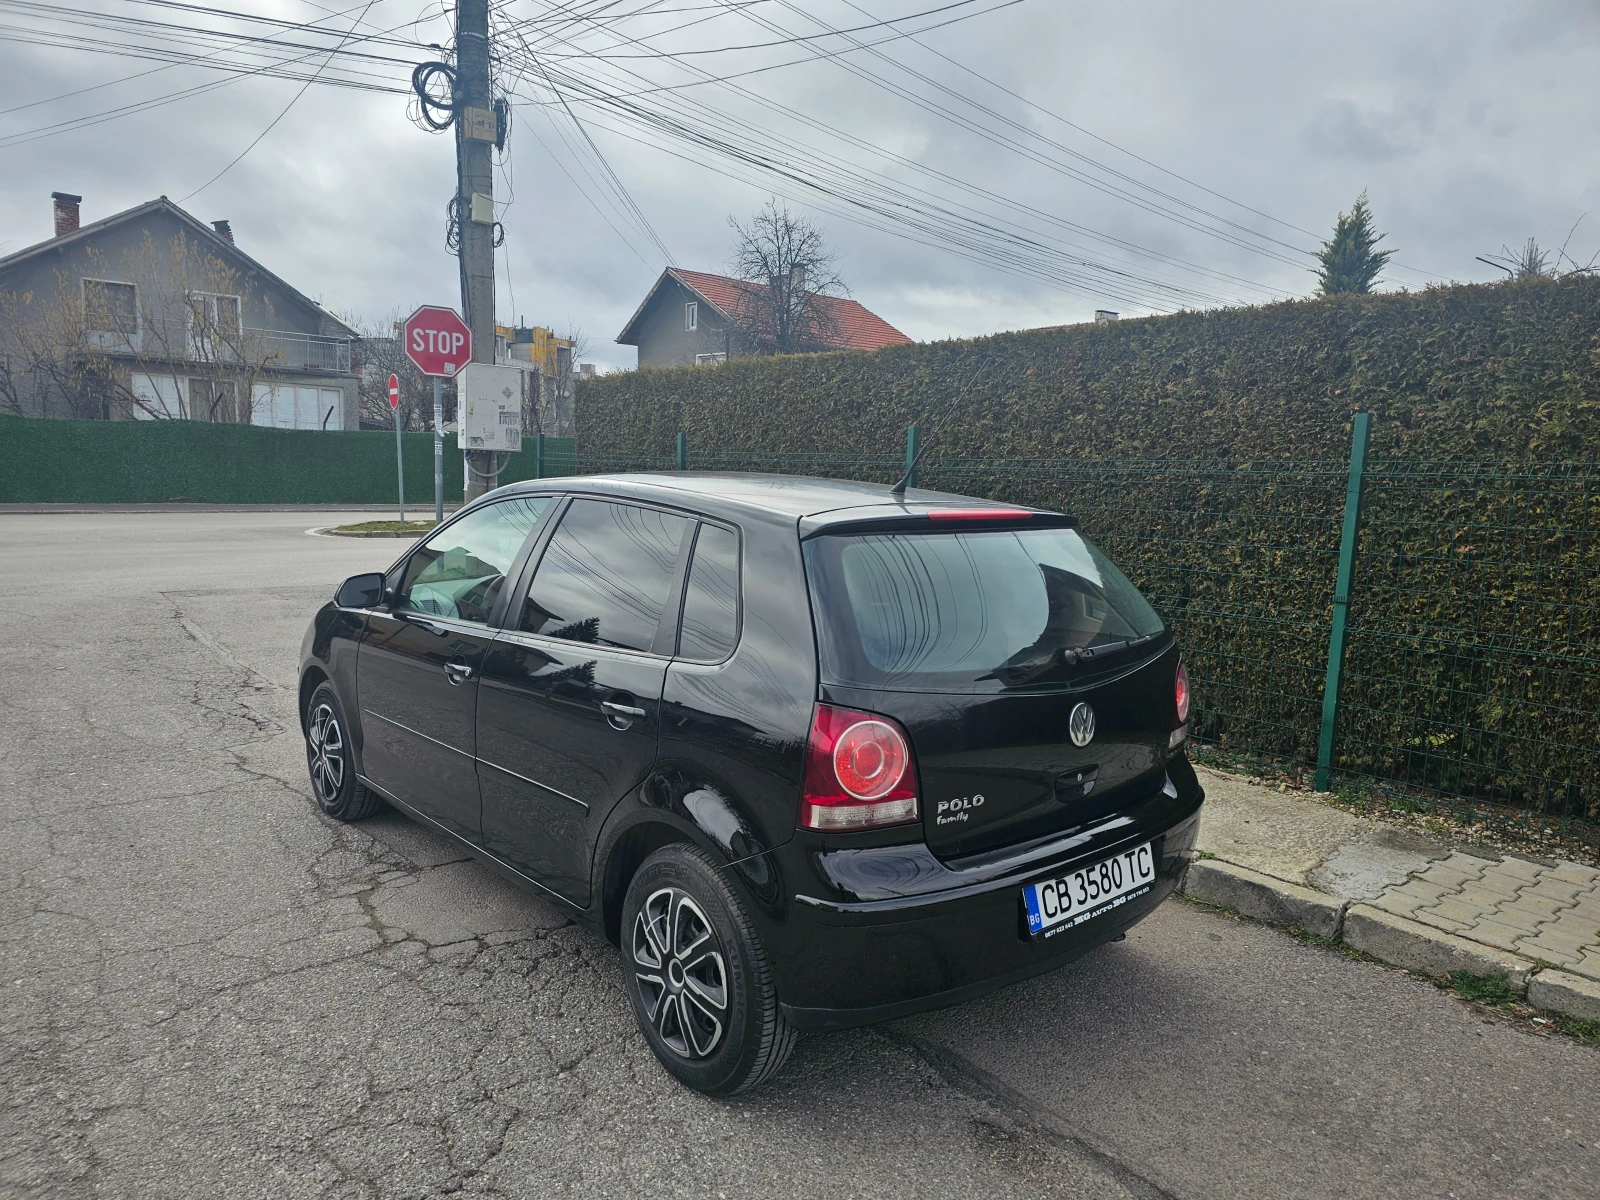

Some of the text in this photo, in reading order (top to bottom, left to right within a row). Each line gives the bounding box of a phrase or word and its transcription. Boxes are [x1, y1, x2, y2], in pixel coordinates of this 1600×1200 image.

[412, 328, 464, 355] STOP
[937, 794, 985, 814] POLO
[937, 811, 969, 825] Family
[1041, 846, 1150, 918] CB 3580 TC
[1029, 913, 1040, 926] BG
[1091, 904, 1113, 918] AUTO
[726, 938, 745, 1020] KUMHO
